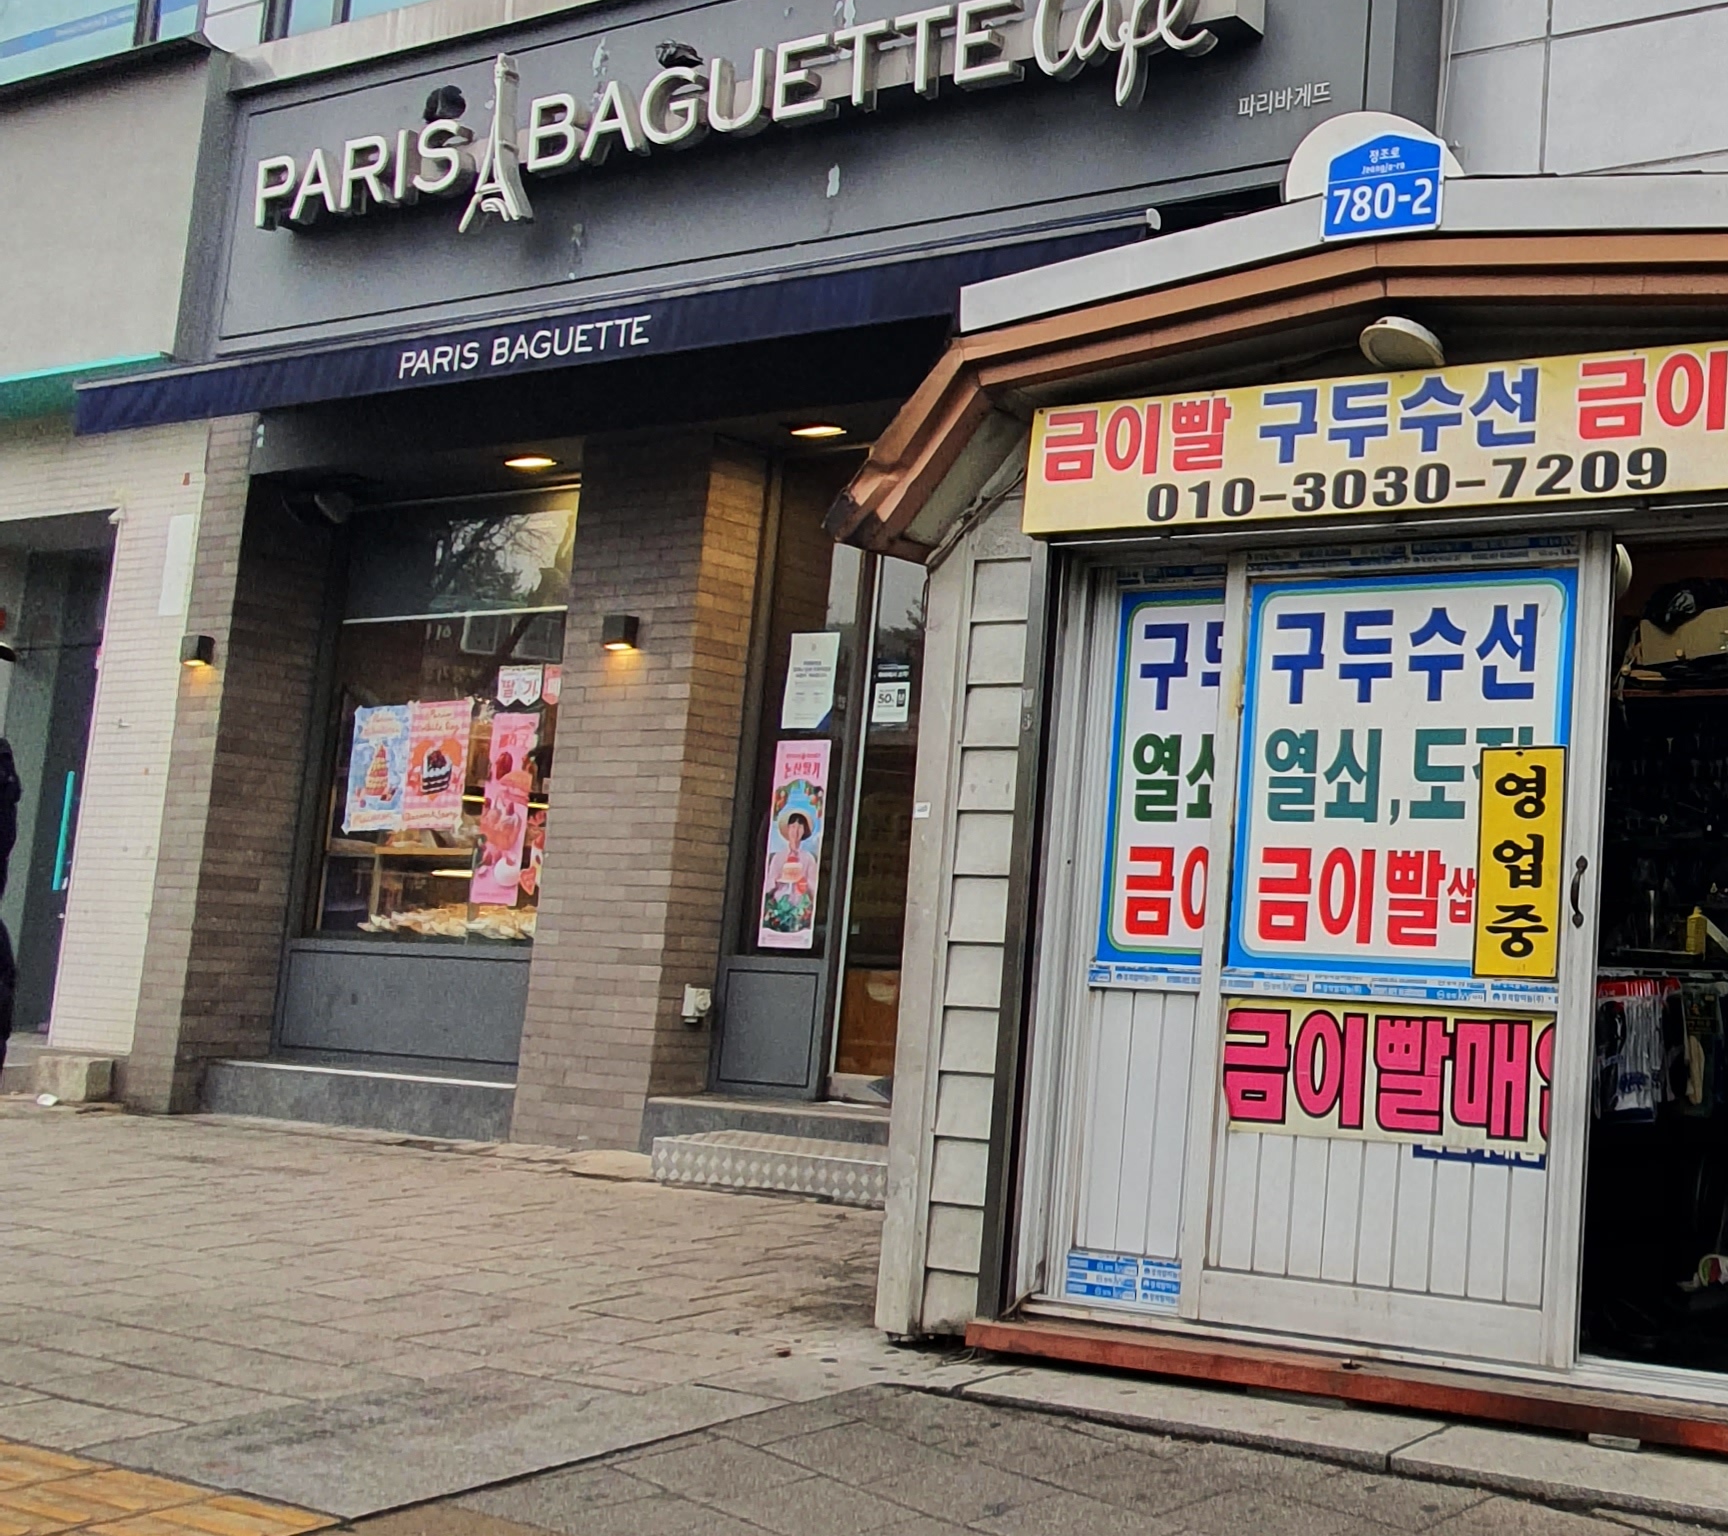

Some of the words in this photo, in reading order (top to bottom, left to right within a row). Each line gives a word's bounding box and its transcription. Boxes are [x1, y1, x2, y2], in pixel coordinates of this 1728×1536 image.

[1237, 81, 1333, 119] 파리바게뜨
[255, 120, 475, 230] PARIS
[1332, 178, 1433, 225] 780-2
[1369, 146, 1401, 163] 정조로
[399, 342, 480, 379] PARIS
[490, 314, 652, 366] BAGUETTE
[1043, 395, 1233, 483] 금이빨
[1259, 369, 1542, 463] 구두수선
[1146, 447, 1668, 522] 010-3030-7209
[1271, 603, 1540, 705] 구두수선
[1265, 725, 1535, 826] 열쇠,도
[1258, 846, 1447, 948] 금이빨
[1485, 764, 1550, 959] 영업중
